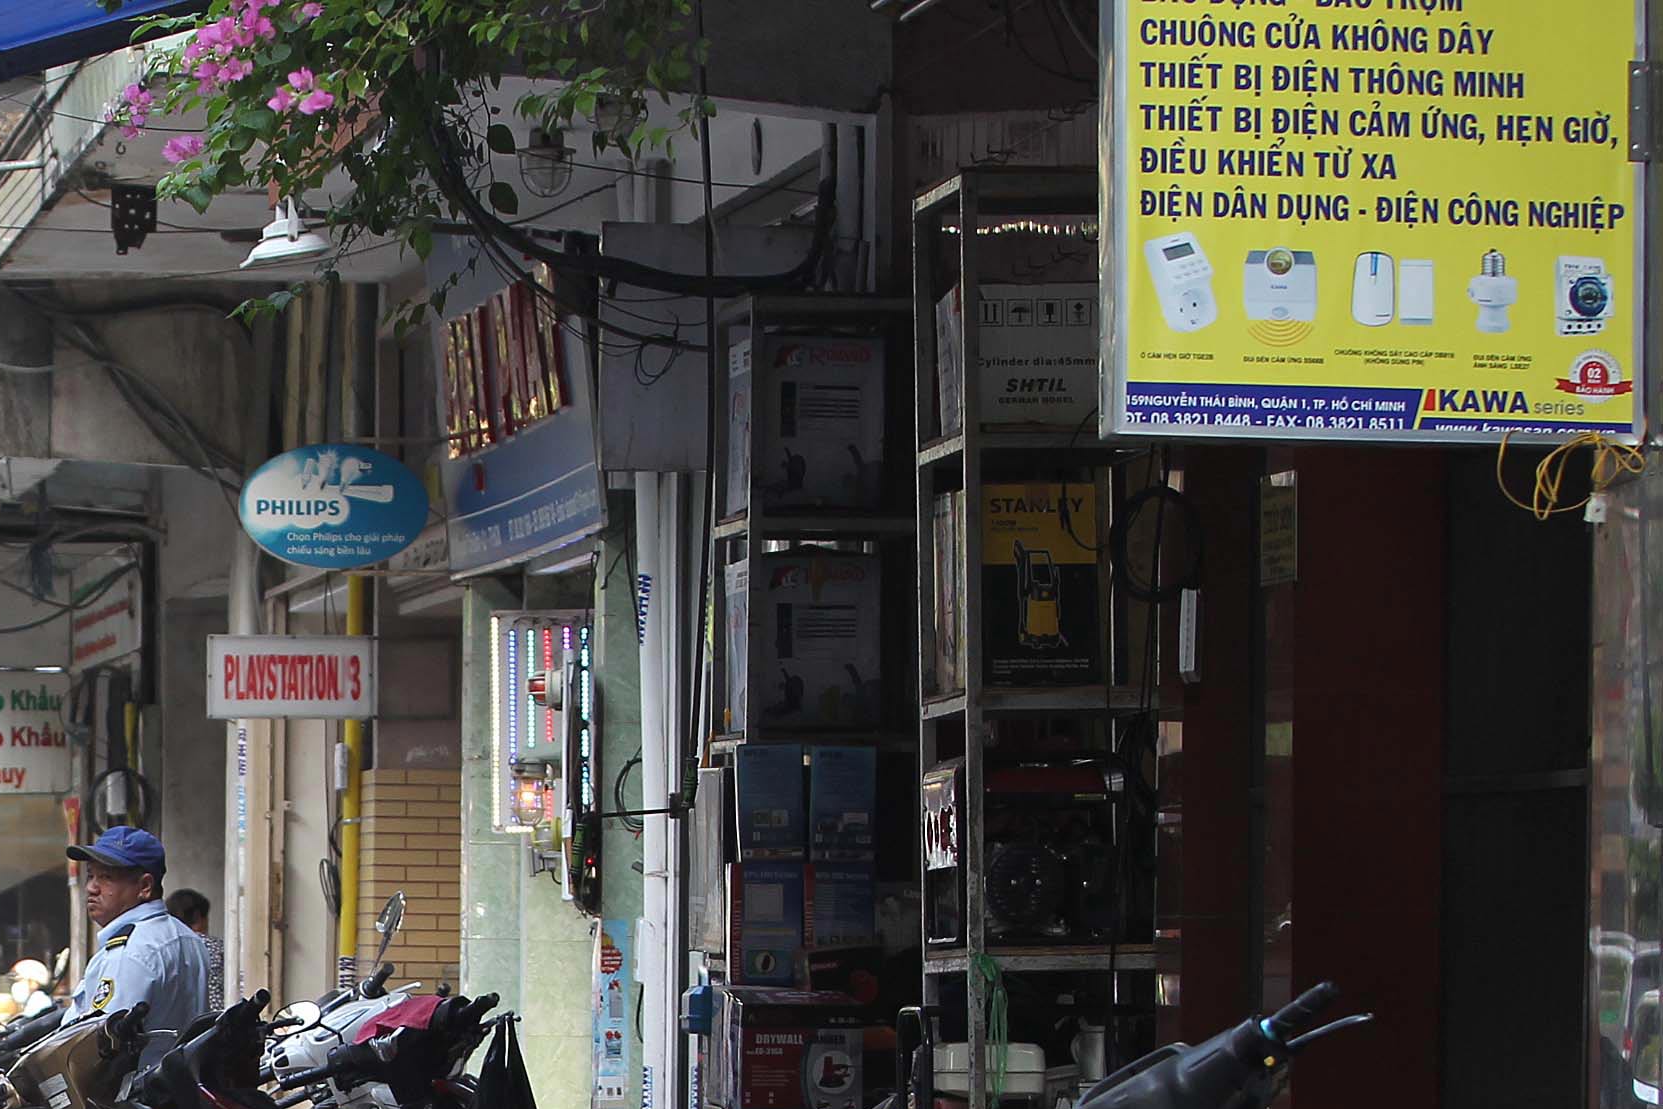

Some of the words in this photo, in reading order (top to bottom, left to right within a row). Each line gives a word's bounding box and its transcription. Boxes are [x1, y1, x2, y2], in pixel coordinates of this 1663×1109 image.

[1140, 13, 1256, 47] CHUÔNG
[1265, 12, 1321, 49] CỬA
[1331, 20, 1428, 54] KHÔNG
[1438, 21, 1494, 55] DÂY
[1140, 52, 1222, 89] THIẾT
[1235, 64, 1262, 96] BỊ
[1272, 59, 1339, 97] ĐIỆN
[1349, 62, 1444, 97] THÔNG
[1454, 71, 1524, 99] MINH
[1140, 95, 1222, 132] THIẾT
[1235, 107, 1262, 139] BỊ
[1272, 102, 1339, 139] ĐIỆN
[1349, 101, 1410, 138] CẢM
[1422, 105, 1485, 144] ỨNG,
[1496, 116, 1553, 147] HẸN
[1563, 110, 1618, 150] GIỜ,
[1140, 137, 1207, 175] ĐIỀU
[1217, 137, 1304, 178] KHIỂN
[1314, 145, 1353, 179] TỪ
[1360, 154, 1396, 180] XA
[1140, 184, 1203, 219] ĐIỆN
[1213, 185, 1268, 219] DÂN
[1277, 195, 1349, 225] DỤNG
[1376, 190, 1439, 229] ĐIỆN
[1448, 192, 1519, 227] CÔNG
[1529, 197, 1625, 235] NGHIỆP
[1006, 378, 1066, 392] SHTIL
[1587, 368, 1601, 378] 02
[1200, 393, 1225, 408] THÁI
[1261, 396, 1297, 411] QUẬN
[1351, 397, 1372, 411] CHÍ
[1375, 400, 1405, 413] MINH
[1438, 388, 1529, 414] KAWA
[1534, 401, 1584, 416] series
[256, 500, 340, 515] PHILIPS
[224, 654, 339, 700] PLAYSTATION
[350, 655, 361, 700] 3
[11, 684, 62, 711] Khẩu
[11, 722, 66, 747] Khẩu
[755, 1033, 803, 1044] DRYWALL
